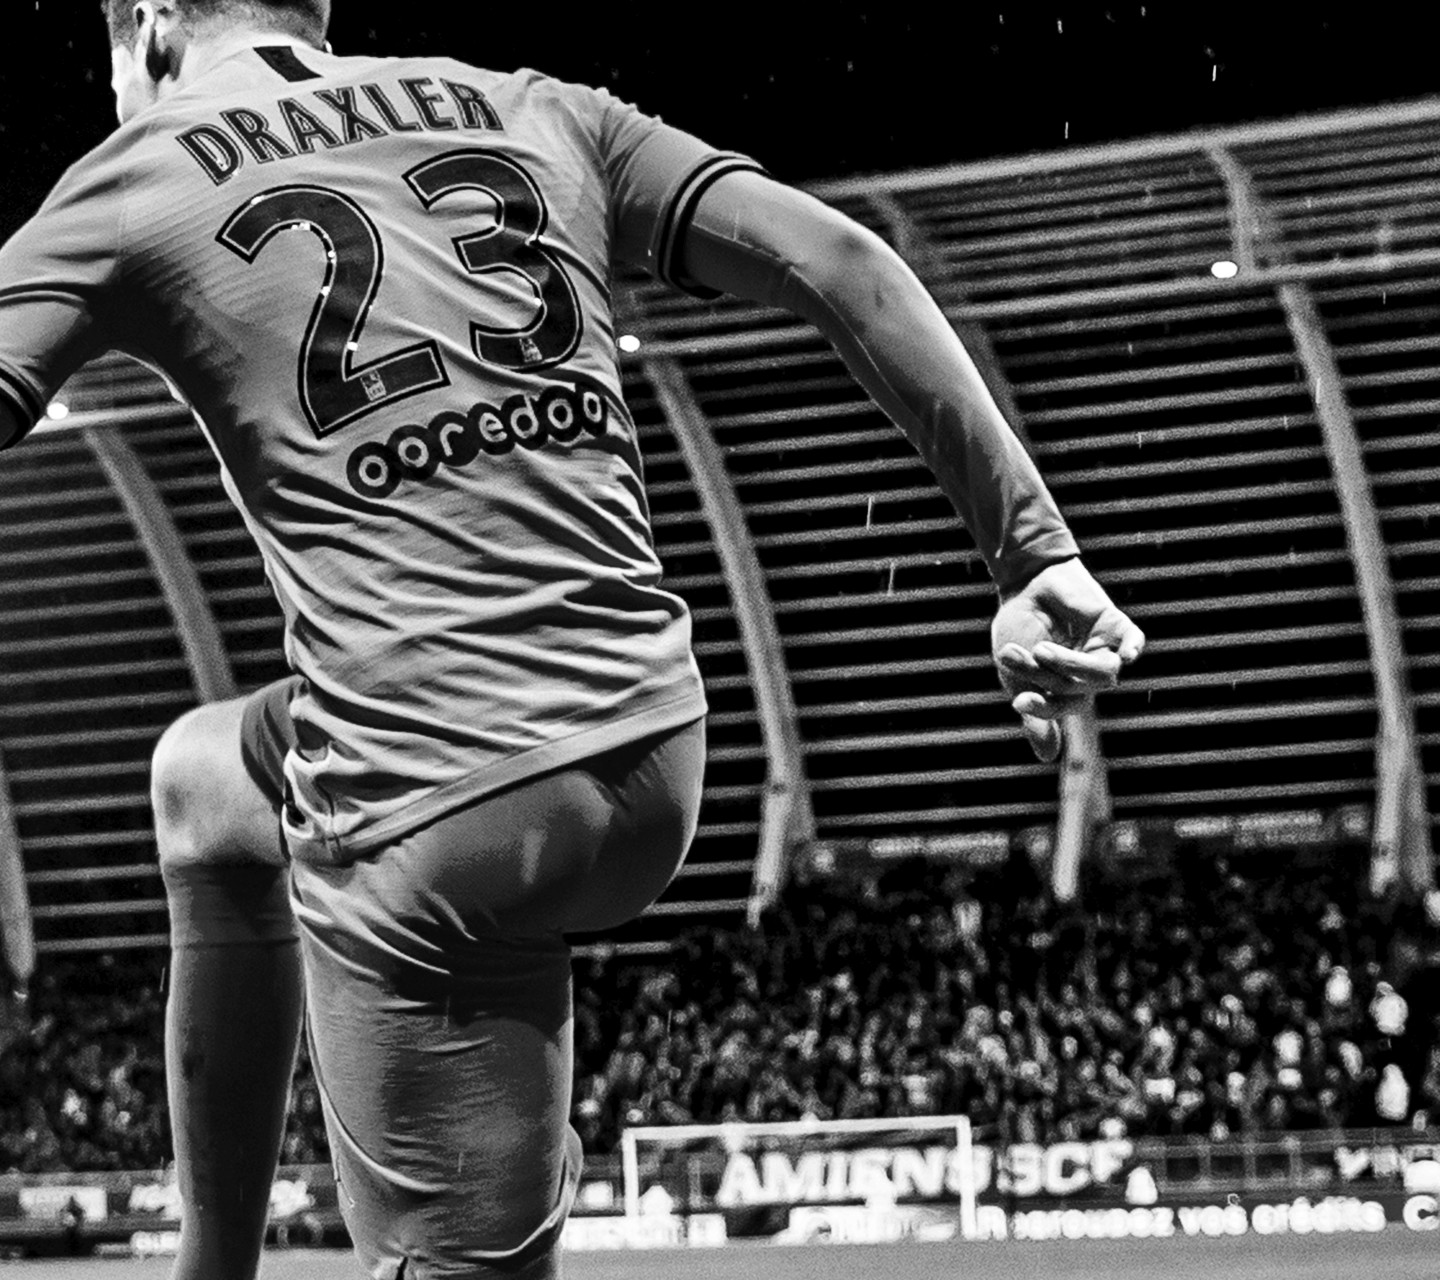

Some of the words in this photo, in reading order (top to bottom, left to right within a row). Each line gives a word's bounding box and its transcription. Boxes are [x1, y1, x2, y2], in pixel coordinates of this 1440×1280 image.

[175, 77, 504, 185] DRAXLER
[215, 148, 583, 440] 23
[346, 382, 610, 499] ooredoo
[718, 1145, 994, 1206] AMIENS
